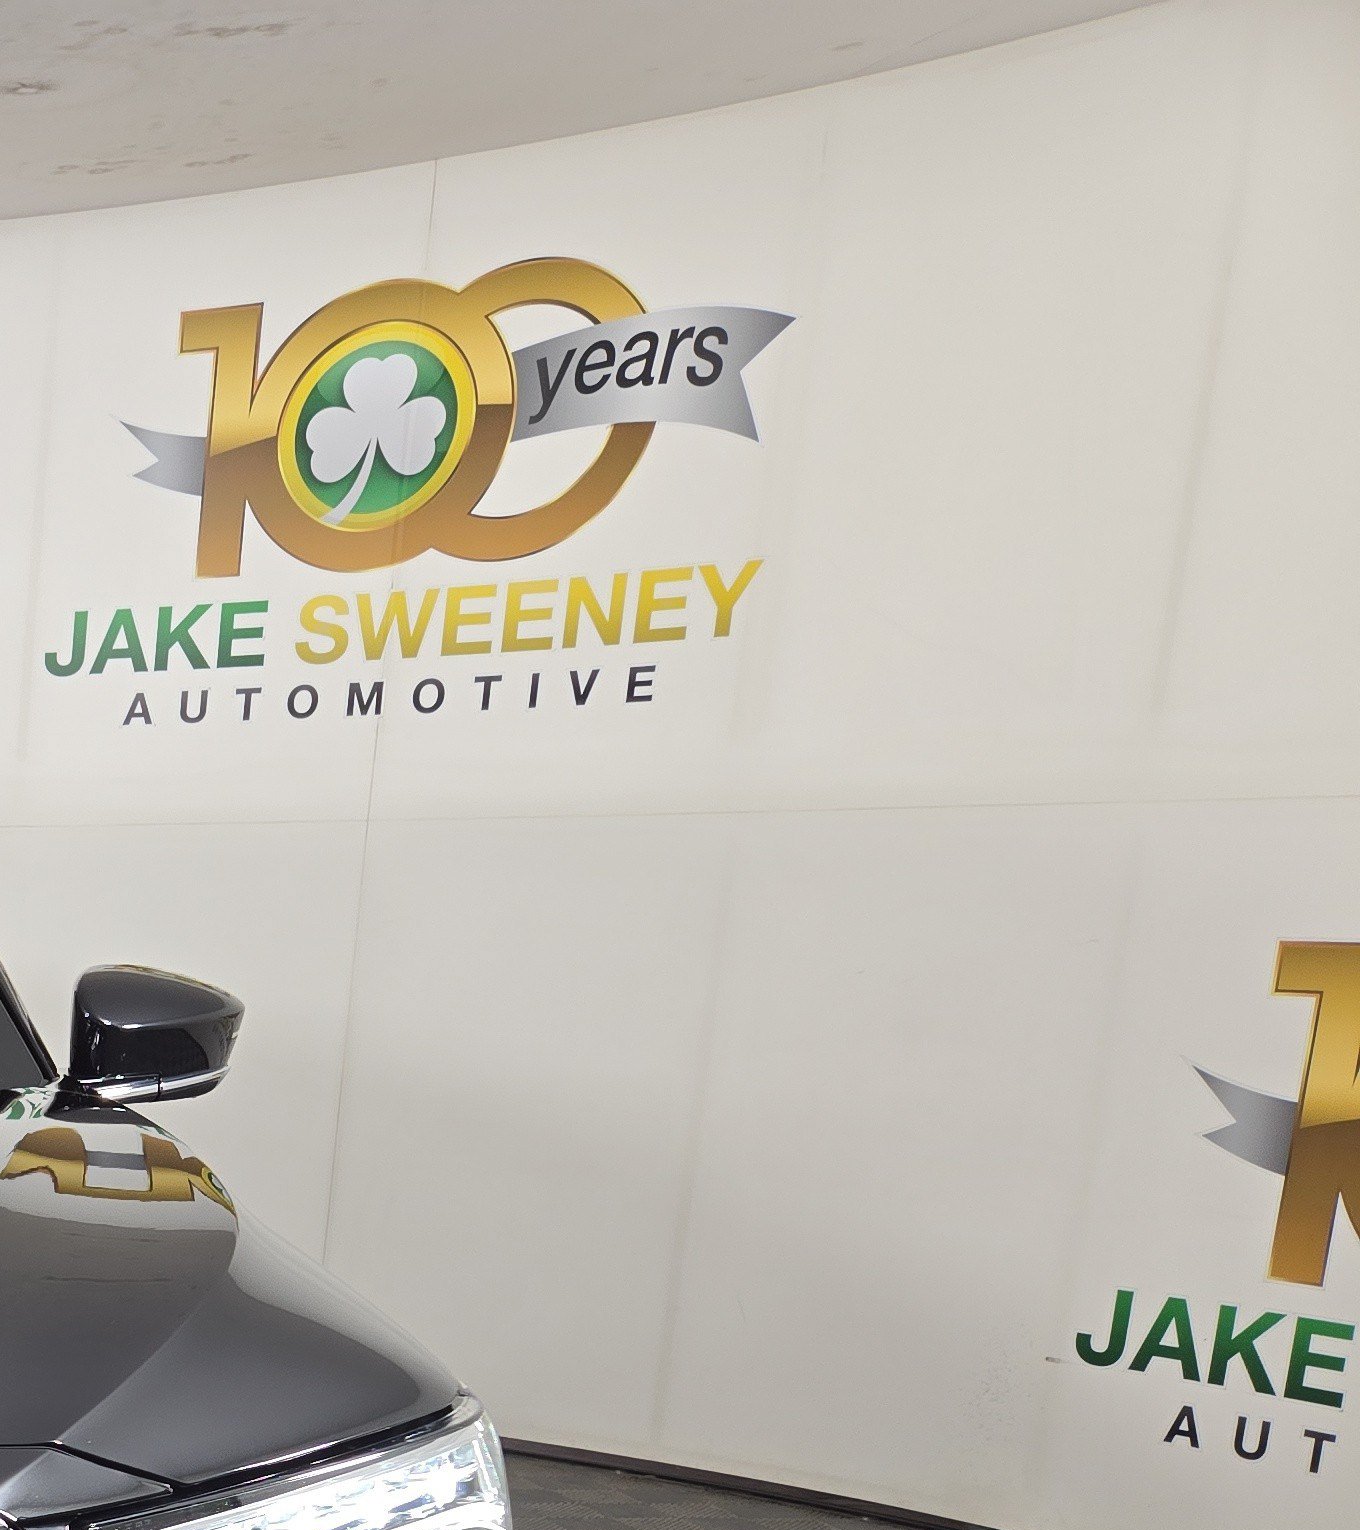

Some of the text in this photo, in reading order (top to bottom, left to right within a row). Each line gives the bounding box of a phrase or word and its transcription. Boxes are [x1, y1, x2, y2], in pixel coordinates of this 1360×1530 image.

[178, 256, 729, 580] 100 years
[43, 557, 765, 678] JAKE SWEENEY
[122, 665, 657, 727] AUTOMOTIVE
[1075, 1288, 1356, 1409] JAKE
[1163, 1405, 1338, 1474] AUT
